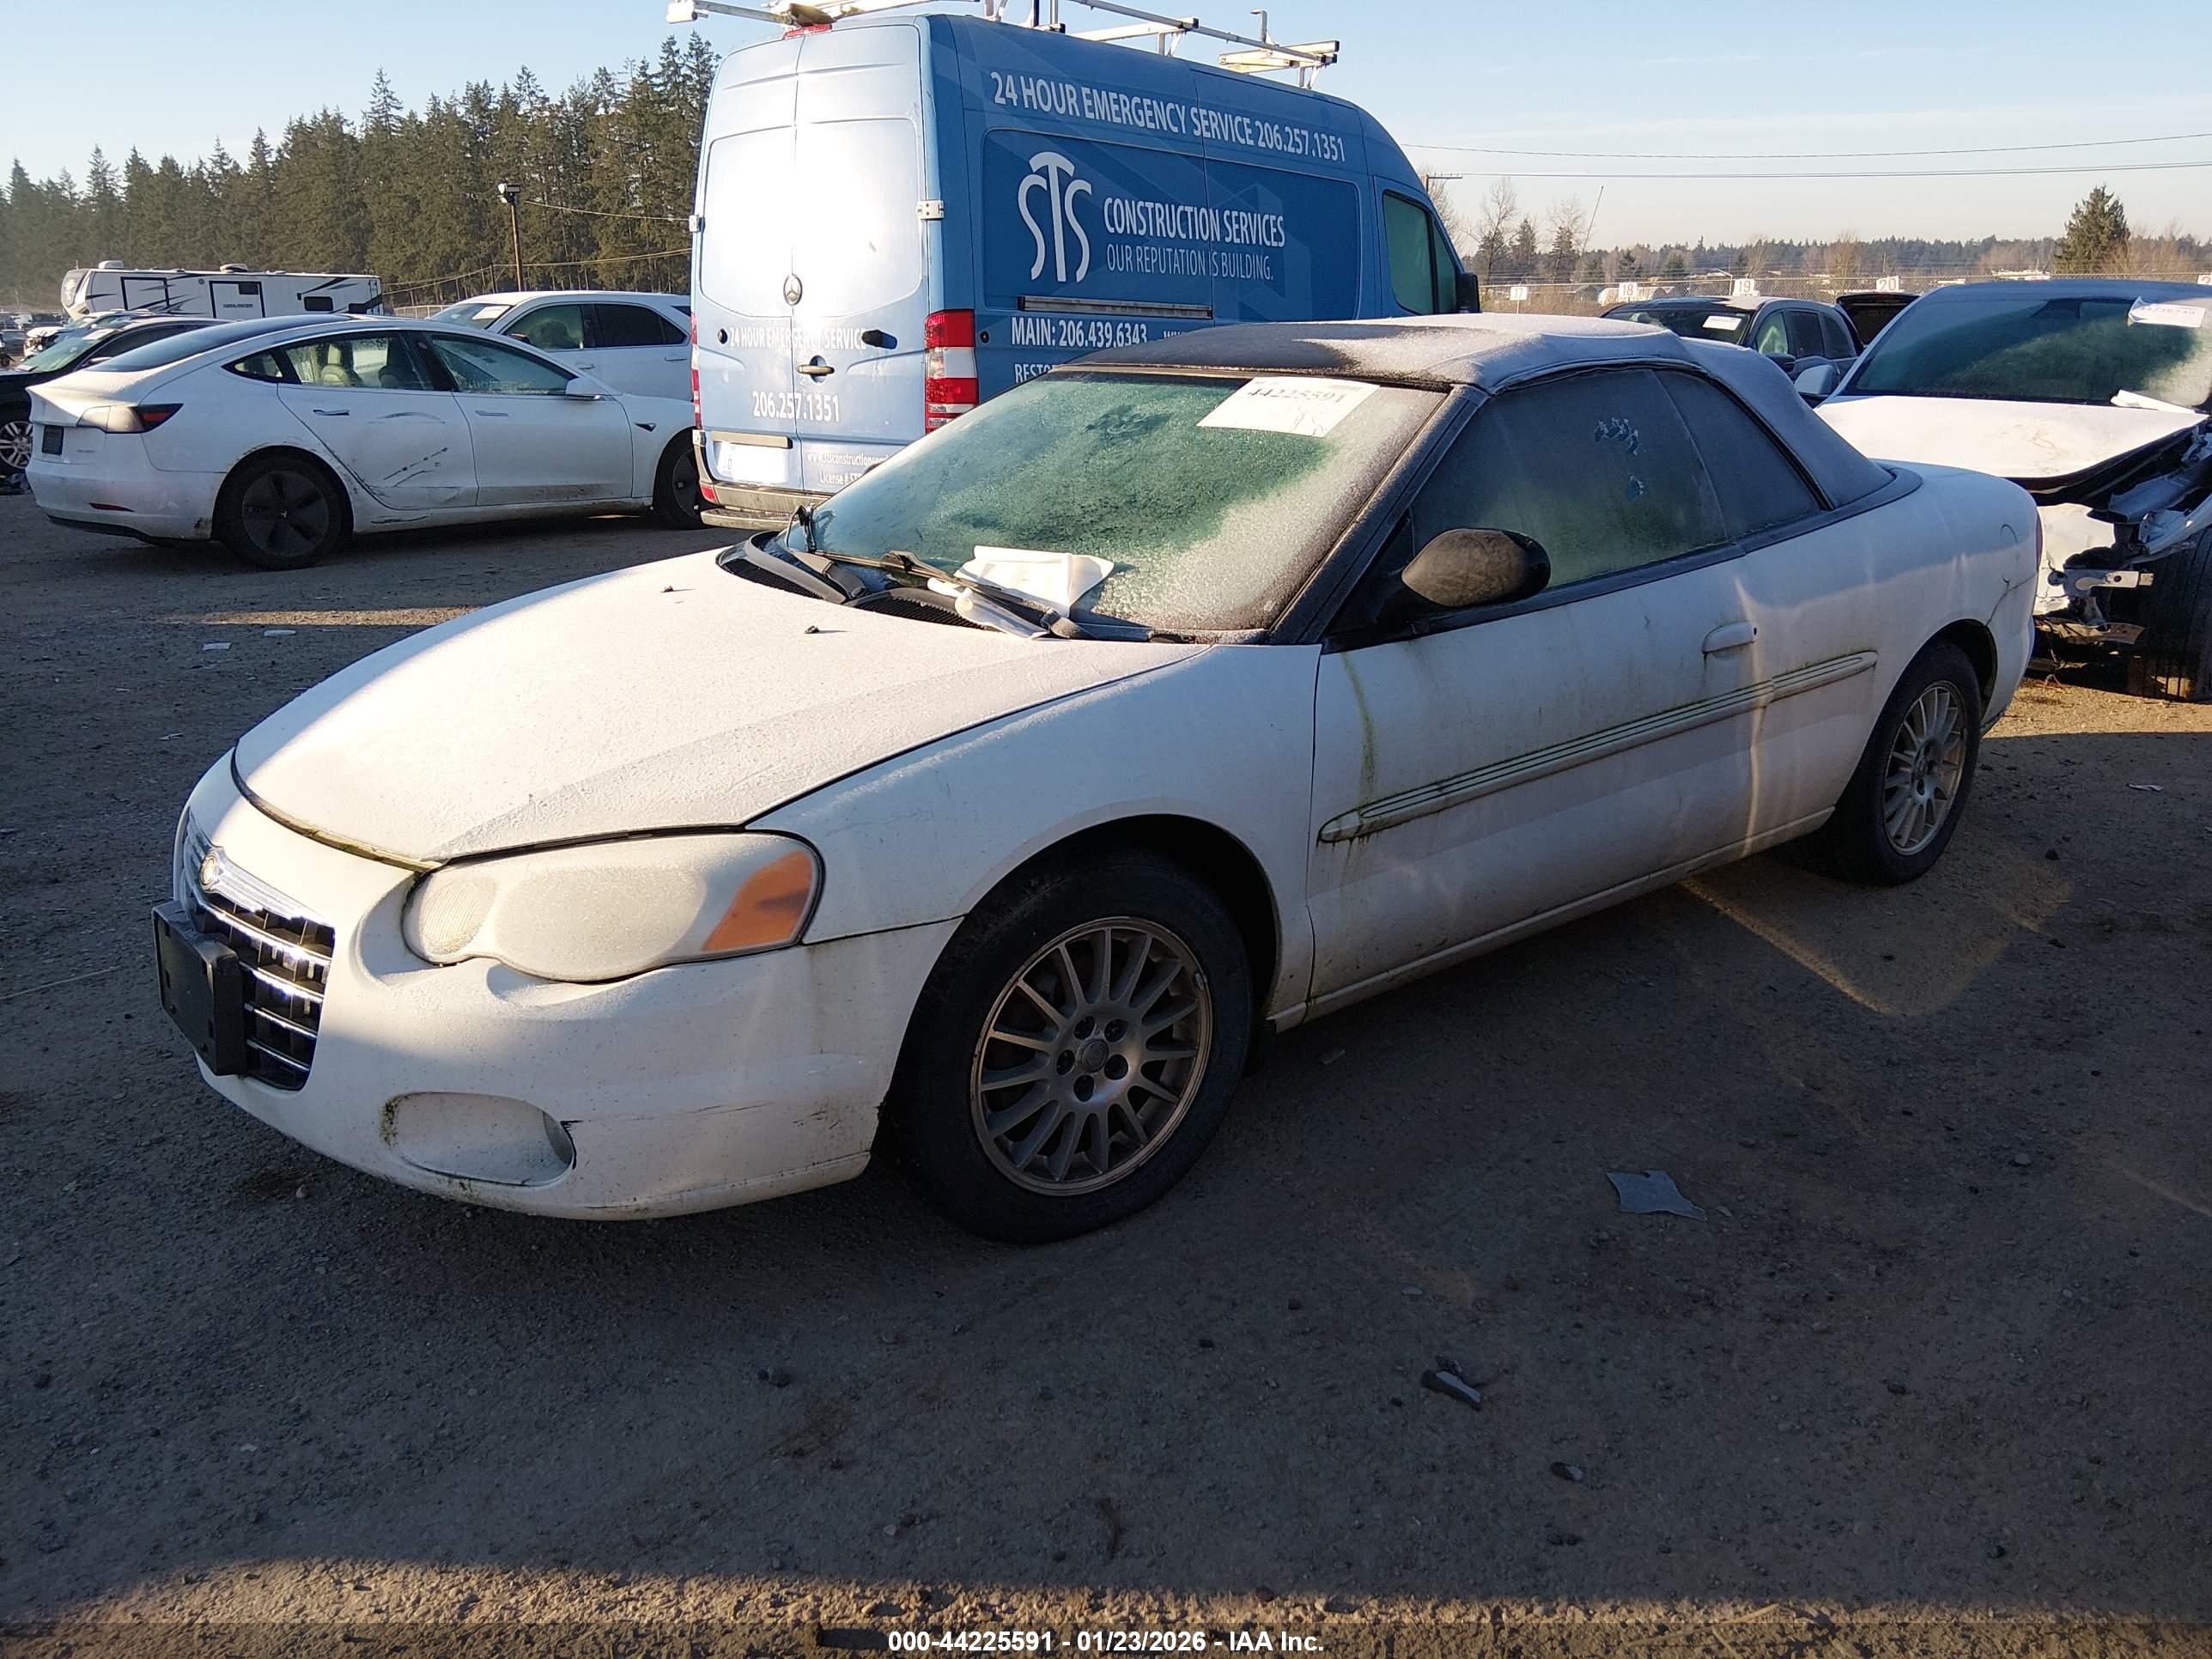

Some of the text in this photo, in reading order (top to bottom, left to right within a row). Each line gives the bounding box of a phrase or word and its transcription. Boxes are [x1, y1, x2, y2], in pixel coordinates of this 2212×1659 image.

[990, 71, 1346, 162] 24 HOUR EMERGENCY SERVICE 206.257.1351
[1018, 151, 1092, 283] STS
[1103, 197, 1285, 248] CONSTRUCTION SERVICES
[1107, 243, 1274, 282] OUR REPUTATION IS BUILDING.
[1515, 288, 1523, 300] 17
[1623, 283, 1634, 296] 18
[1739, 280, 1751, 293] 19
[1880, 277, 1897, 291] 20
[730, 326, 740, 347] 24
[741, 327, 765, 348] HOUR
[824, 327, 866, 350] SERVICE
[1012, 317, 1147, 348] MAIN: 206.439.6343
[752, 391, 840, 422] 206.257.1351
[819, 467, 844, 485] License
